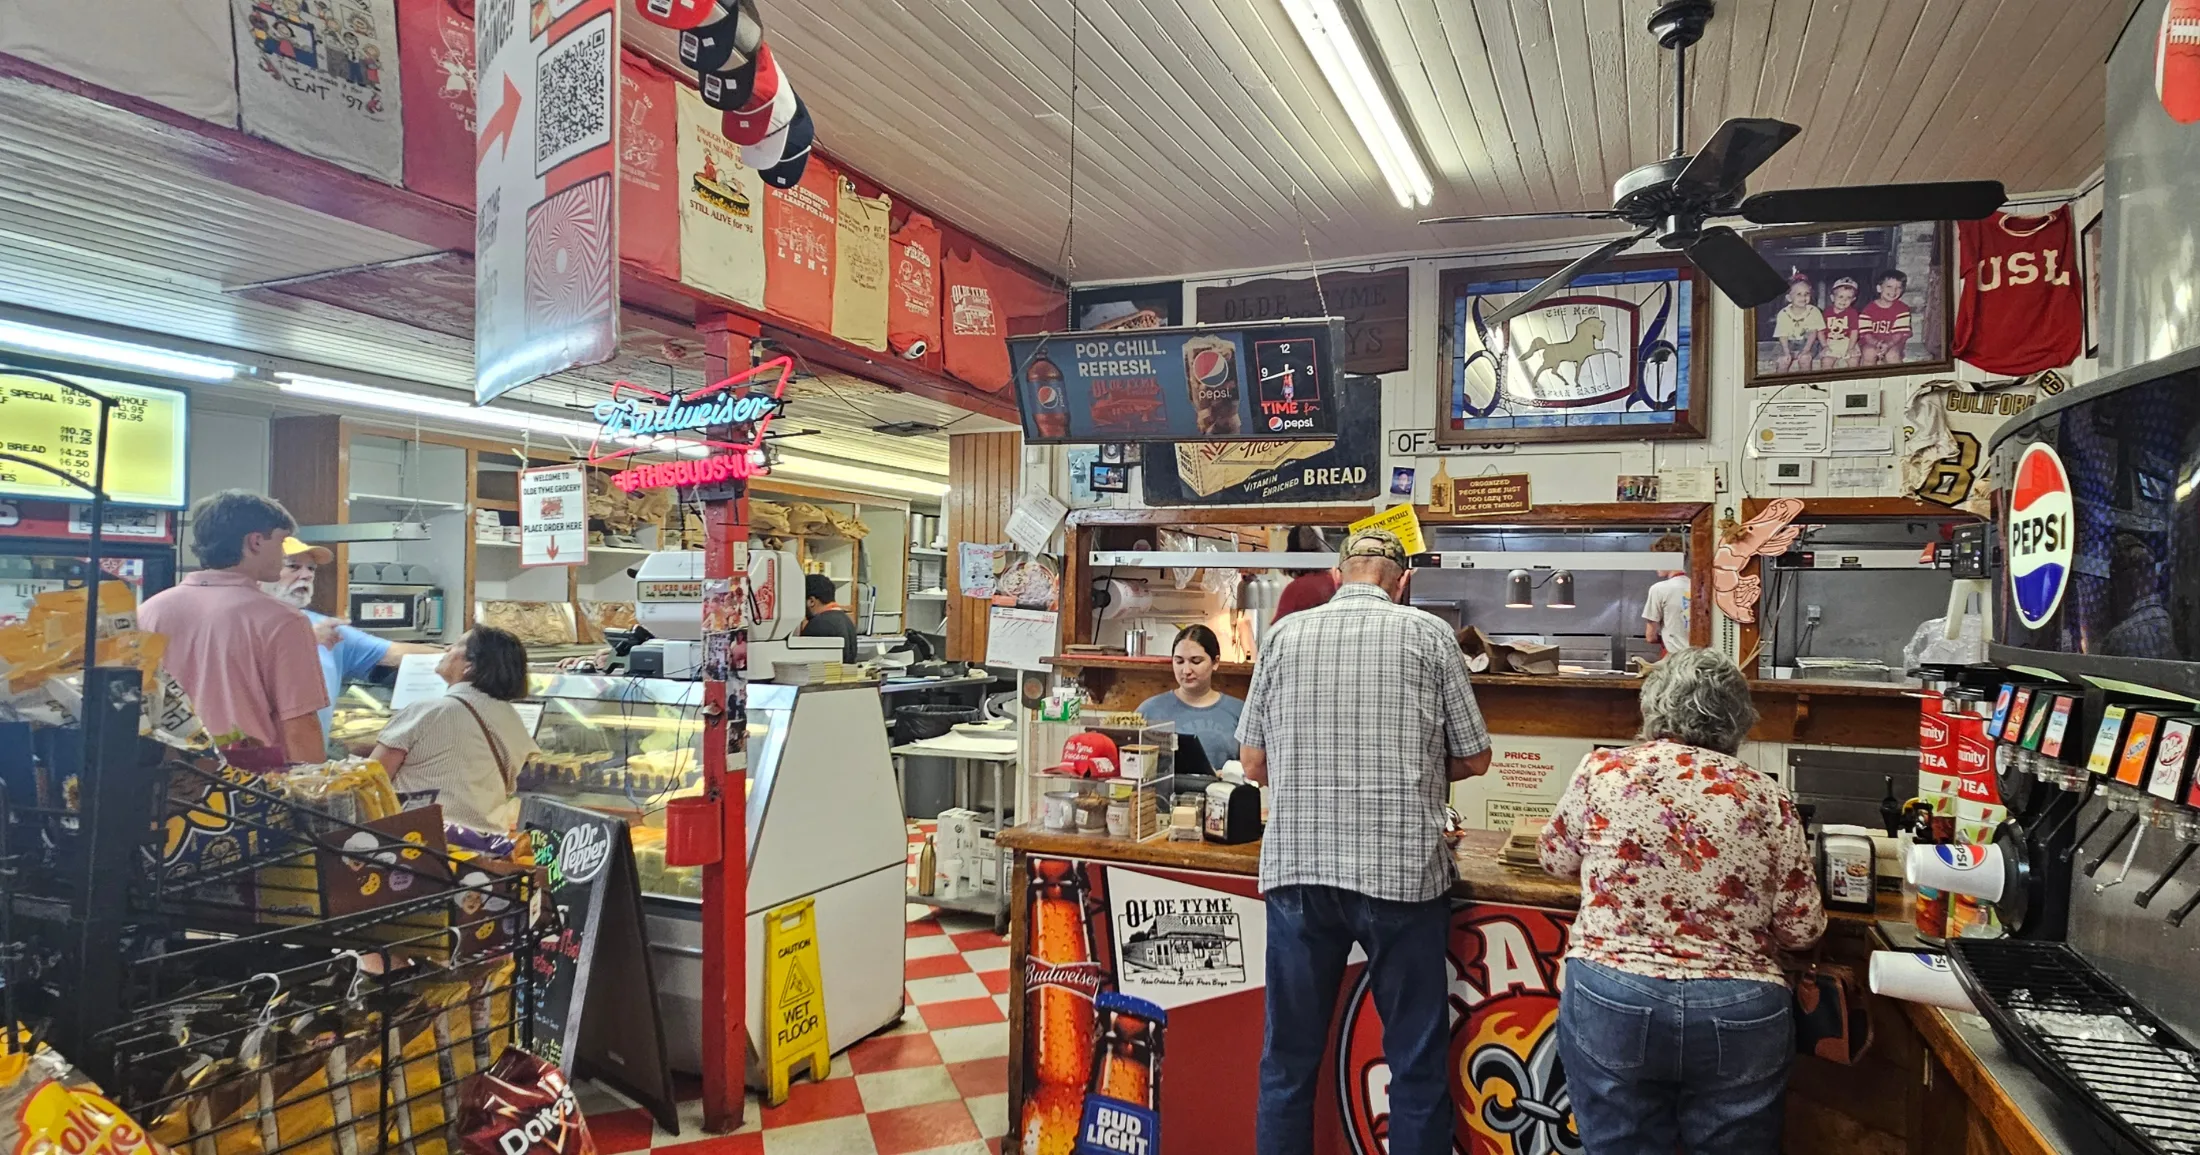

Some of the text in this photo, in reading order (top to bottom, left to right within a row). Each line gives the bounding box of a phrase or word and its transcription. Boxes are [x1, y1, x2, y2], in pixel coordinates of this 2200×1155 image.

[282, 75, 330, 100] LENT
[689, 200, 710, 216] STILL
[711, 210, 731, 226] ALIVE
[733, 220, 743, 231] for
[1975, 249, 2070, 292] USL
[1075, 340, 1167, 359] POP. CHILL.
[1280, 343, 1291, 354] 12
[1078, 359, 1157, 377] REFRESH.
[1261, 366, 1314, 377] 9 3
[10, 389, 57, 402] SPECIAL
[1198, 389, 1231, 401] pepsi
[594, 392, 776, 442] Budweiser
[1261, 402, 1320, 415] TIME for
[1284, 417, 1314, 430] pepsi
[7, 442, 47, 454] BREAD
[1243, 474, 1279, 493] VITAMIN
[1303, 467, 1367, 486] BREAD
[1262, 478, 1299, 497] ENRICHED
[523, 521, 583, 533] PLACE ORDER HERE
[2012, 512, 2067, 557] PEPSI
[1504, 751, 1541, 760] PRICES
[1924, 754, 1948, 769] TEA
[1963, 780, 1989, 796] TEA
[578, 822, 599, 849] Dr
[561, 827, 607, 874] Pepper
[1125, 897, 1232, 928] OLDE TYME
[1181, 915, 1235, 926] GROCERY
[778, 938, 812, 959] CAUTION
[1026, 963, 1099, 991] Budweiser
[783, 1000, 811, 1024] WET
[778, 1016, 819, 1047] FLOOR
[1097, 1108, 1141, 1137] BUD
[1087, 1123, 1148, 1155] LIGHT
